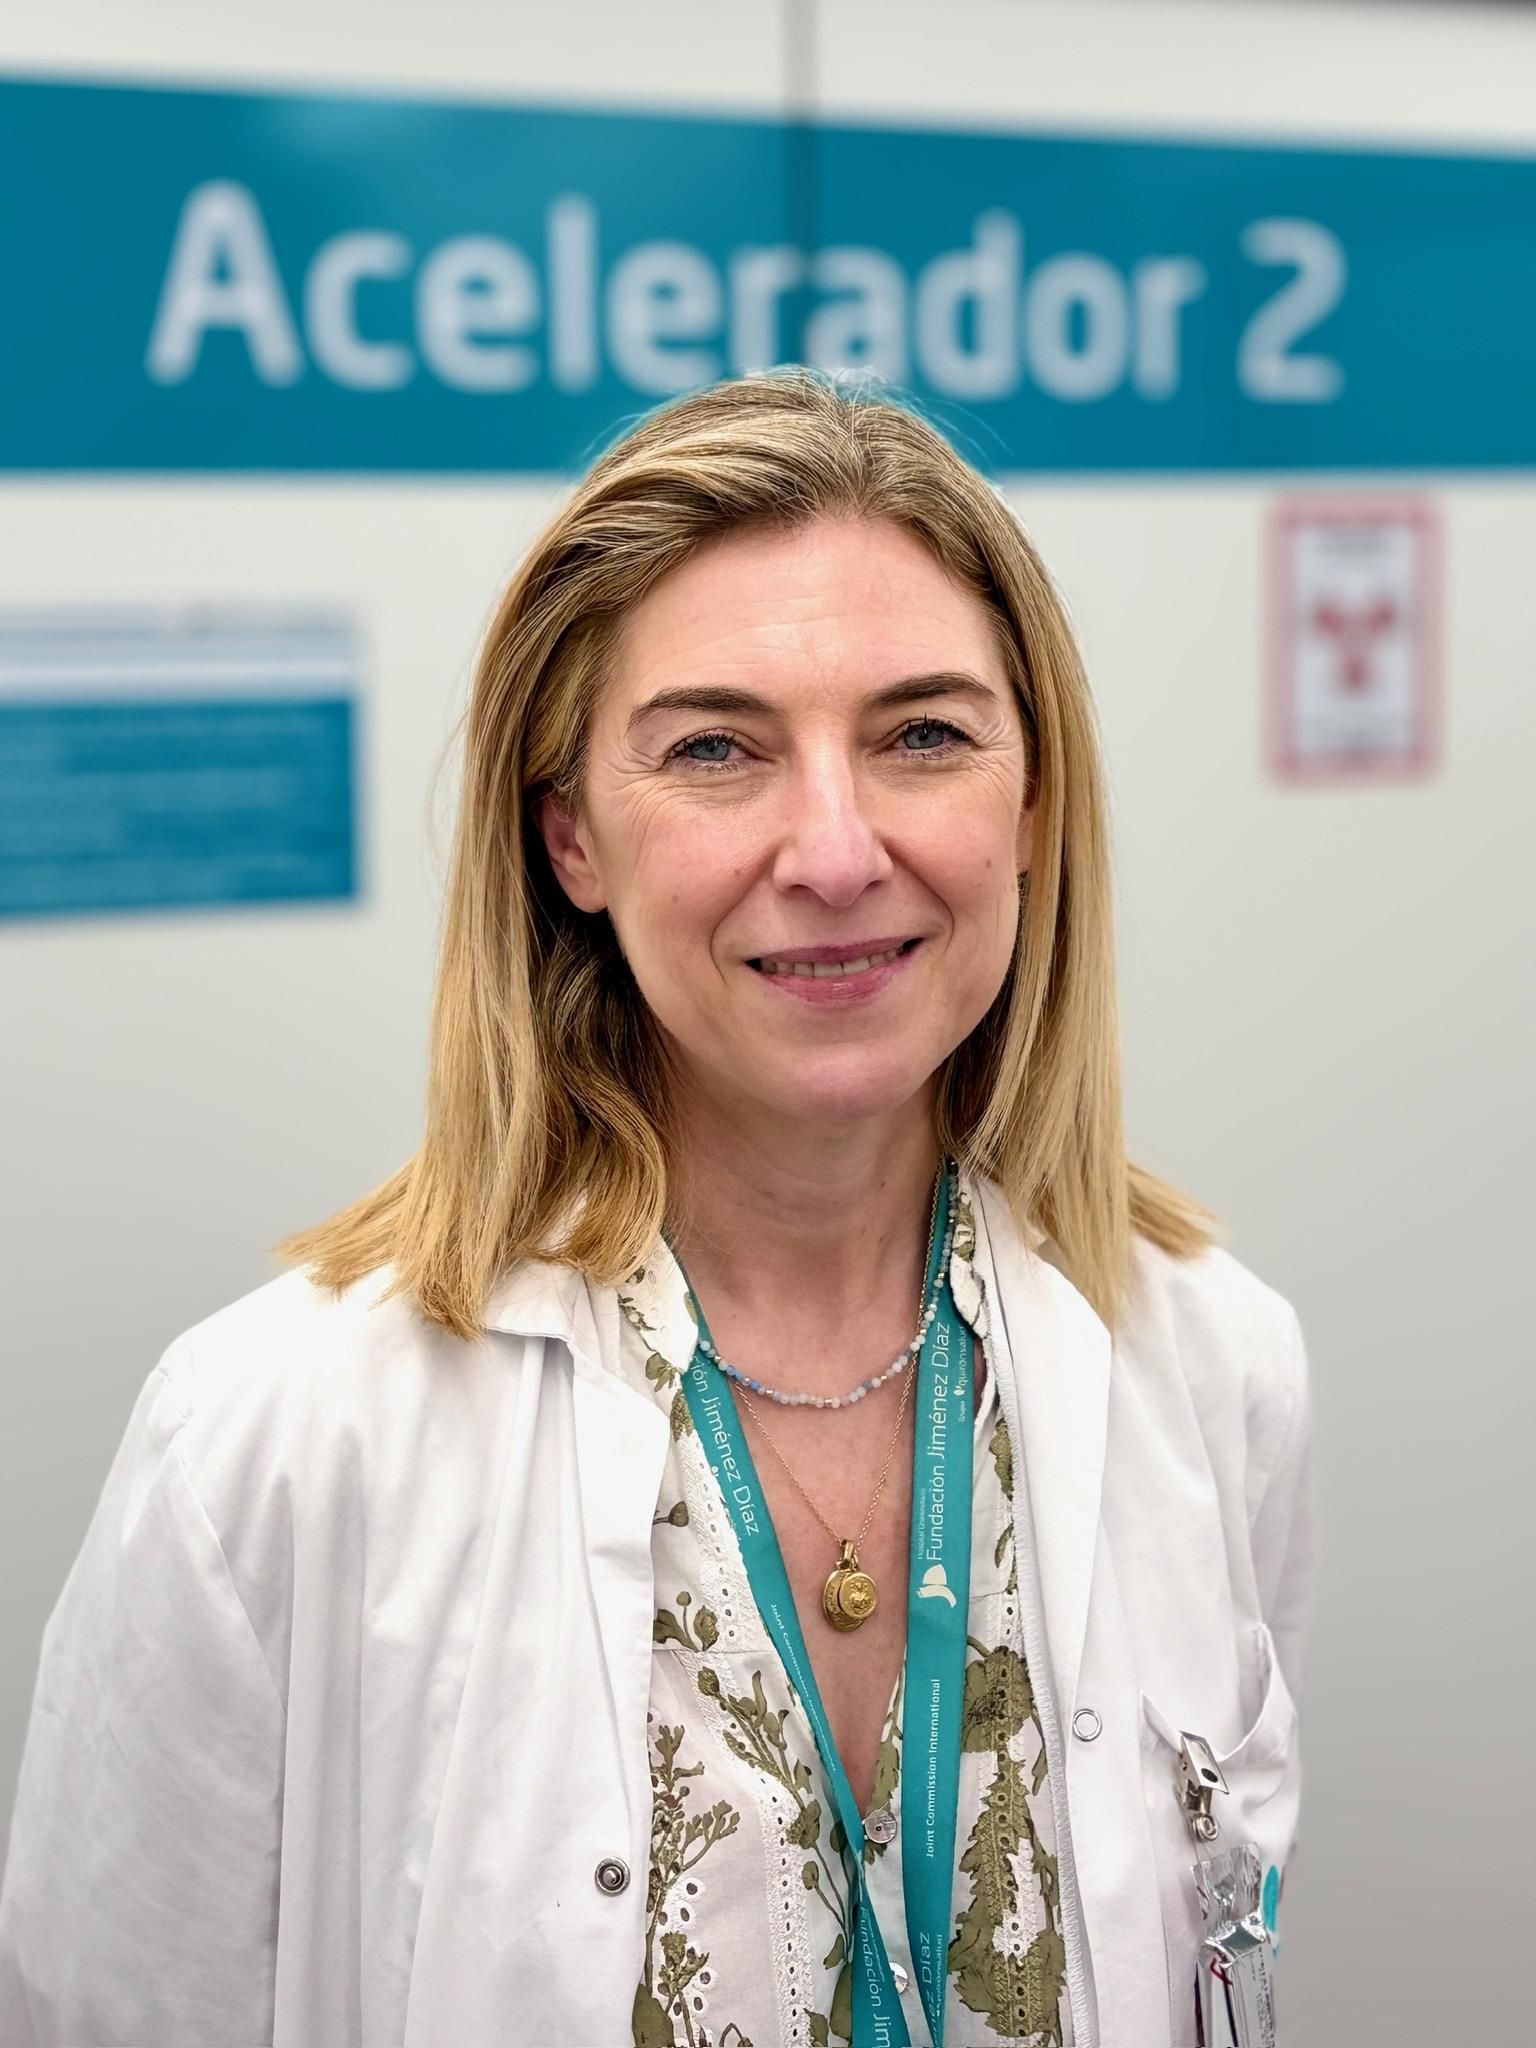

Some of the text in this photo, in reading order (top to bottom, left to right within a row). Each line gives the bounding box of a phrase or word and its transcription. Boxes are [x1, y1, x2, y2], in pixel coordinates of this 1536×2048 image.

[147, 178, 1347, 403] Acelerador 2
[701, 1396, 742, 1484] Jiménez
[732, 1485, 760, 1537] Díaz
[926, 1321, 950, 1561] Fundación Jiménez Díaz
[926, 1679, 940, 1858] Joint Commission International
